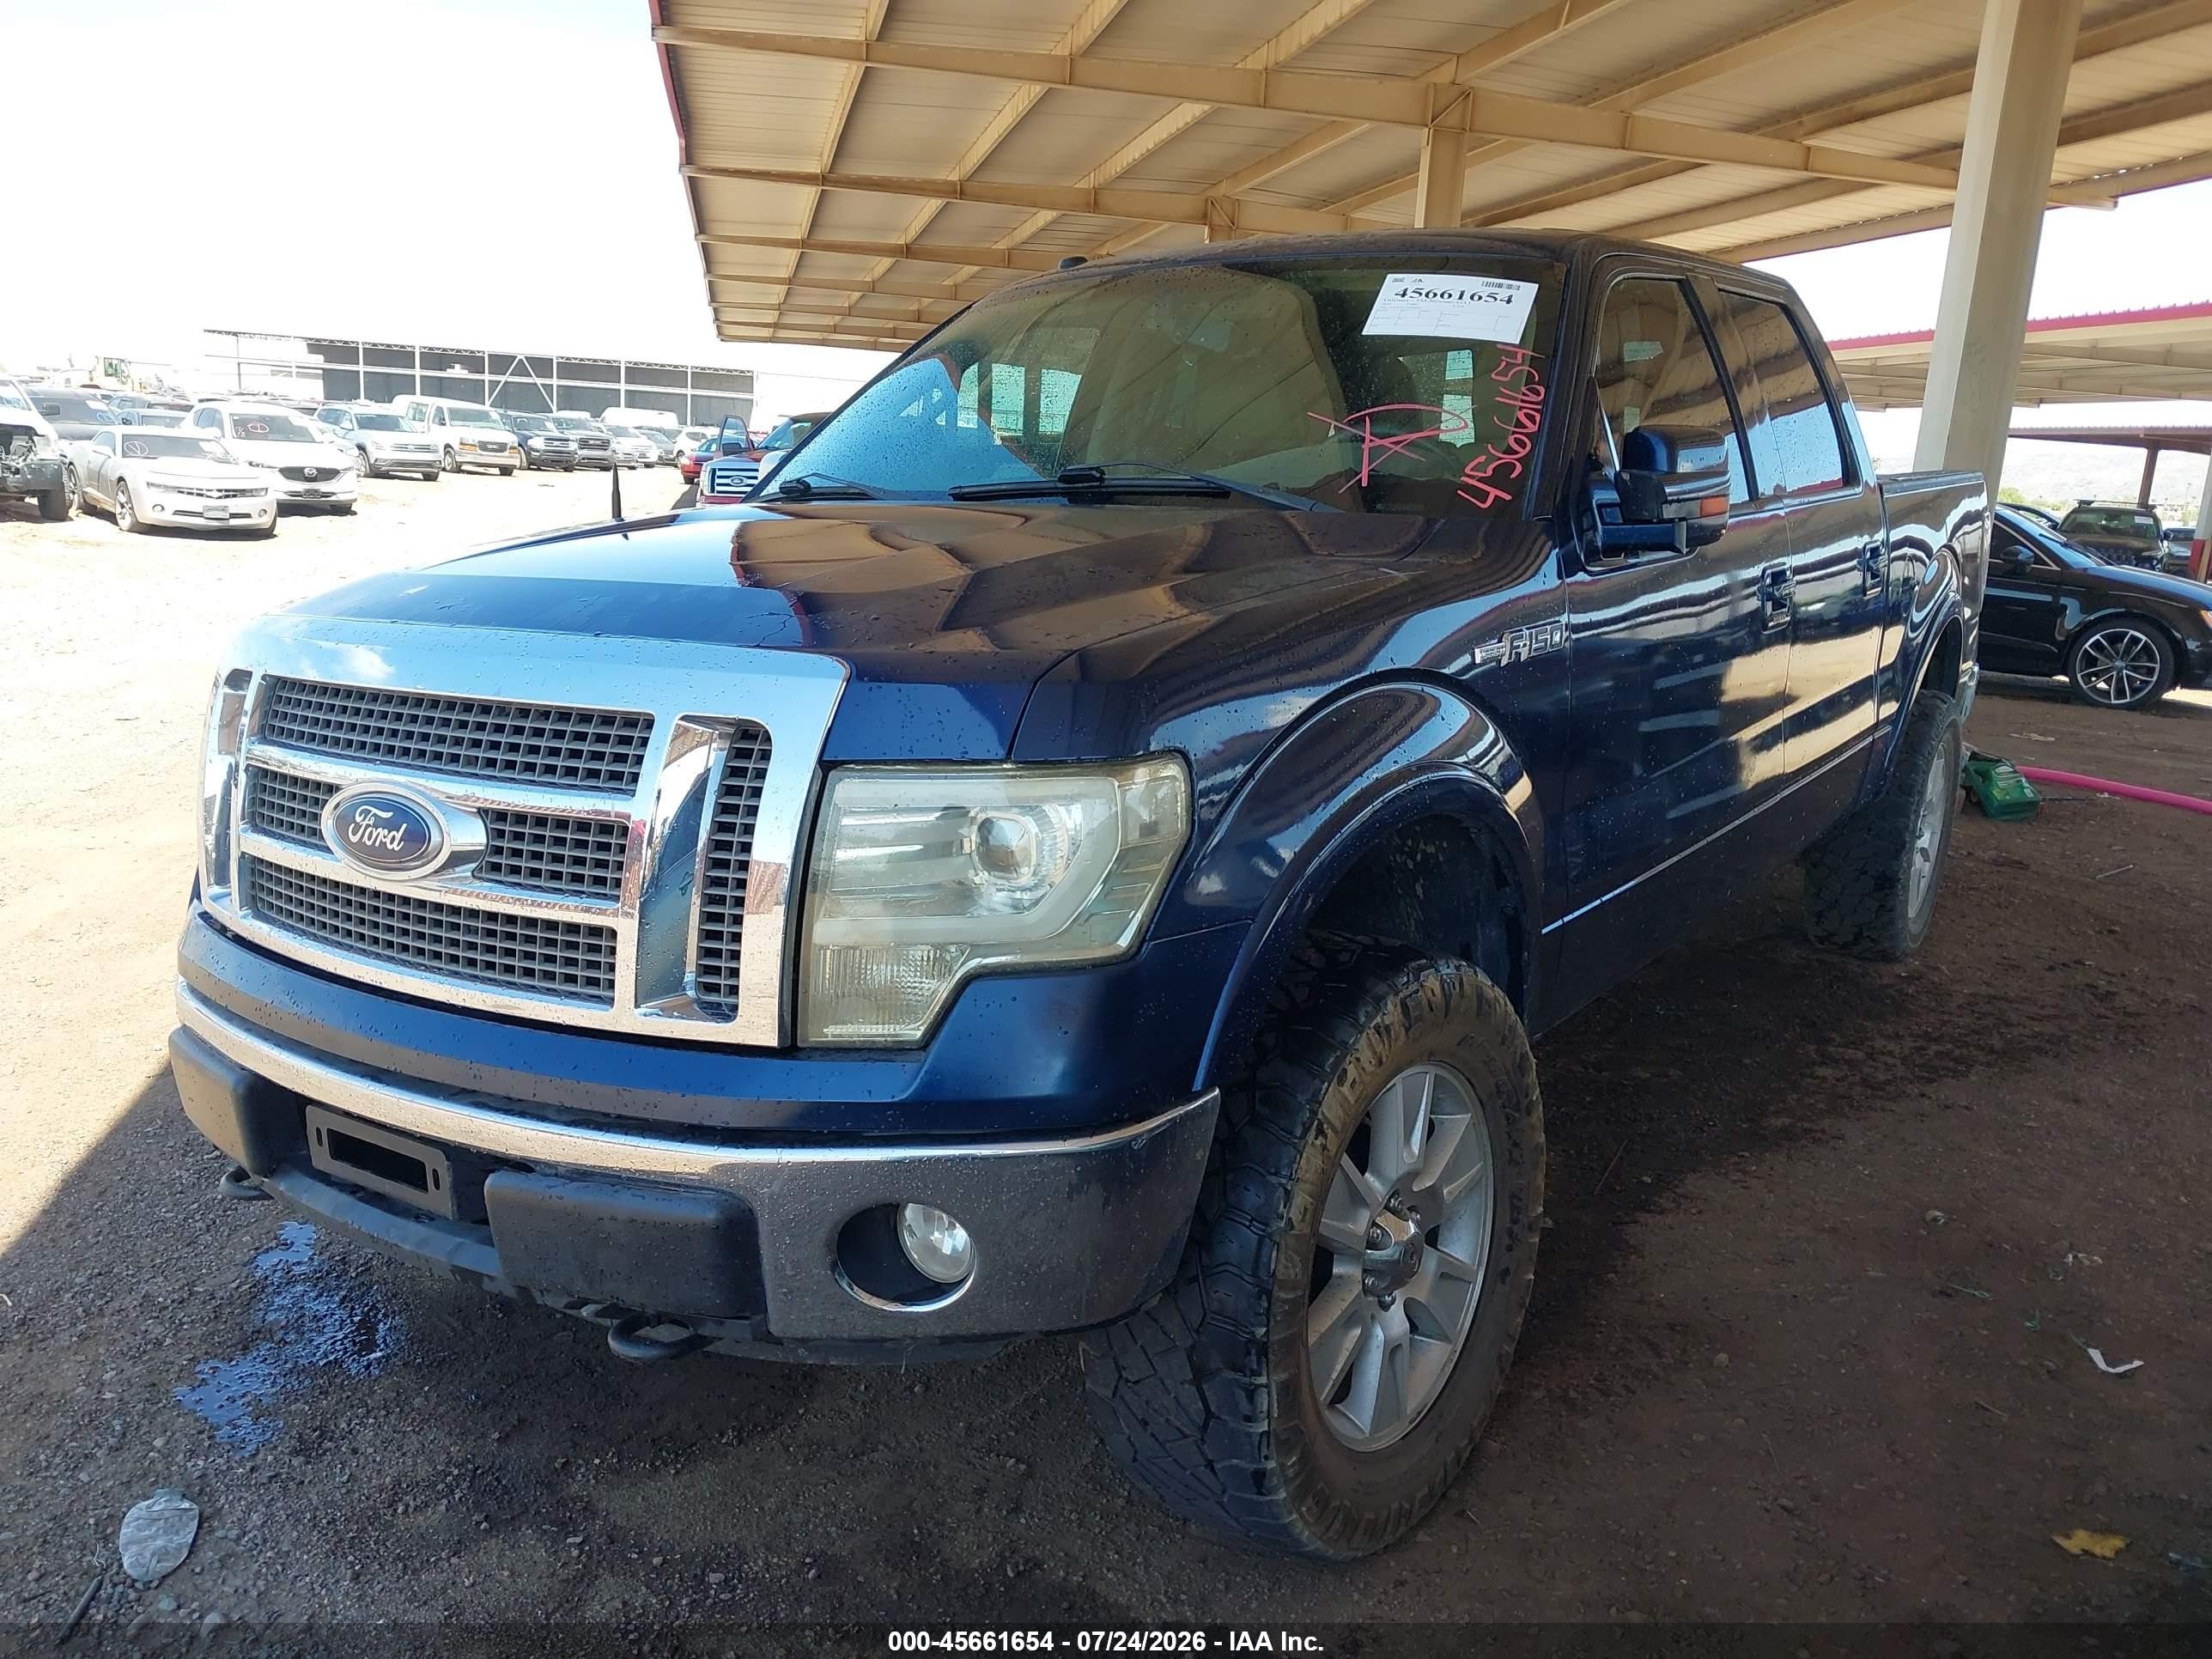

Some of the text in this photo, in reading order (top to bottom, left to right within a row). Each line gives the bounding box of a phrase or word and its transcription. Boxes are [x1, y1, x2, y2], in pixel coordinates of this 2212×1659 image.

[1394, 287, 1514, 305] 45661654
[1456, 343, 1546, 508] 45661654
[348, 805, 408, 851] Ford
